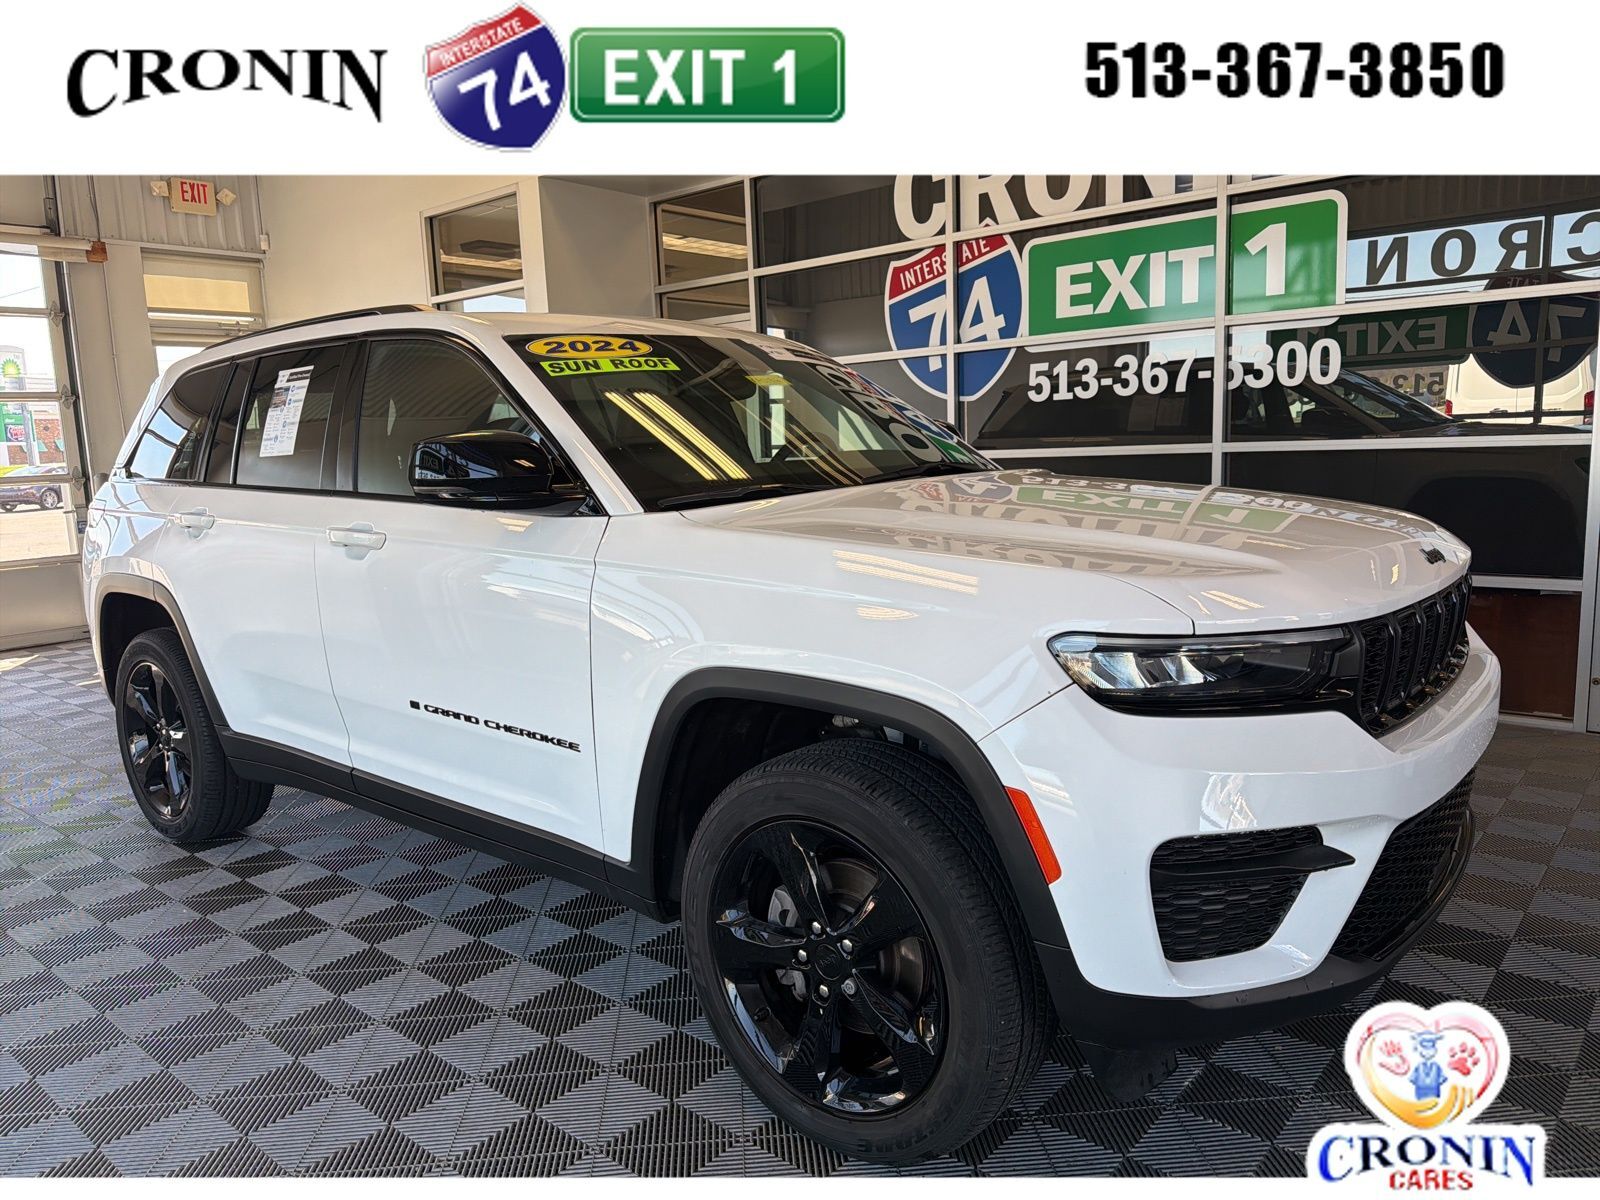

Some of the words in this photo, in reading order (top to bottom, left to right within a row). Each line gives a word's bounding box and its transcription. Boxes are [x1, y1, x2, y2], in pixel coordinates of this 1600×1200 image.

[180, 181, 208, 204] EXIT
[900, 238, 992, 291] INTERSATE
[1055, 244, 1215, 319] EXIT
[1243, 222, 1287, 297] 1
[543, 339, 640, 356] 2024
[908, 275, 1006, 373] 74
[548, 359, 603, 374] SUN
[609, 358, 673, 370] ROOF
[424, 704, 480, 725] GRAND
[484, 719, 582, 753] CHEROKEE
